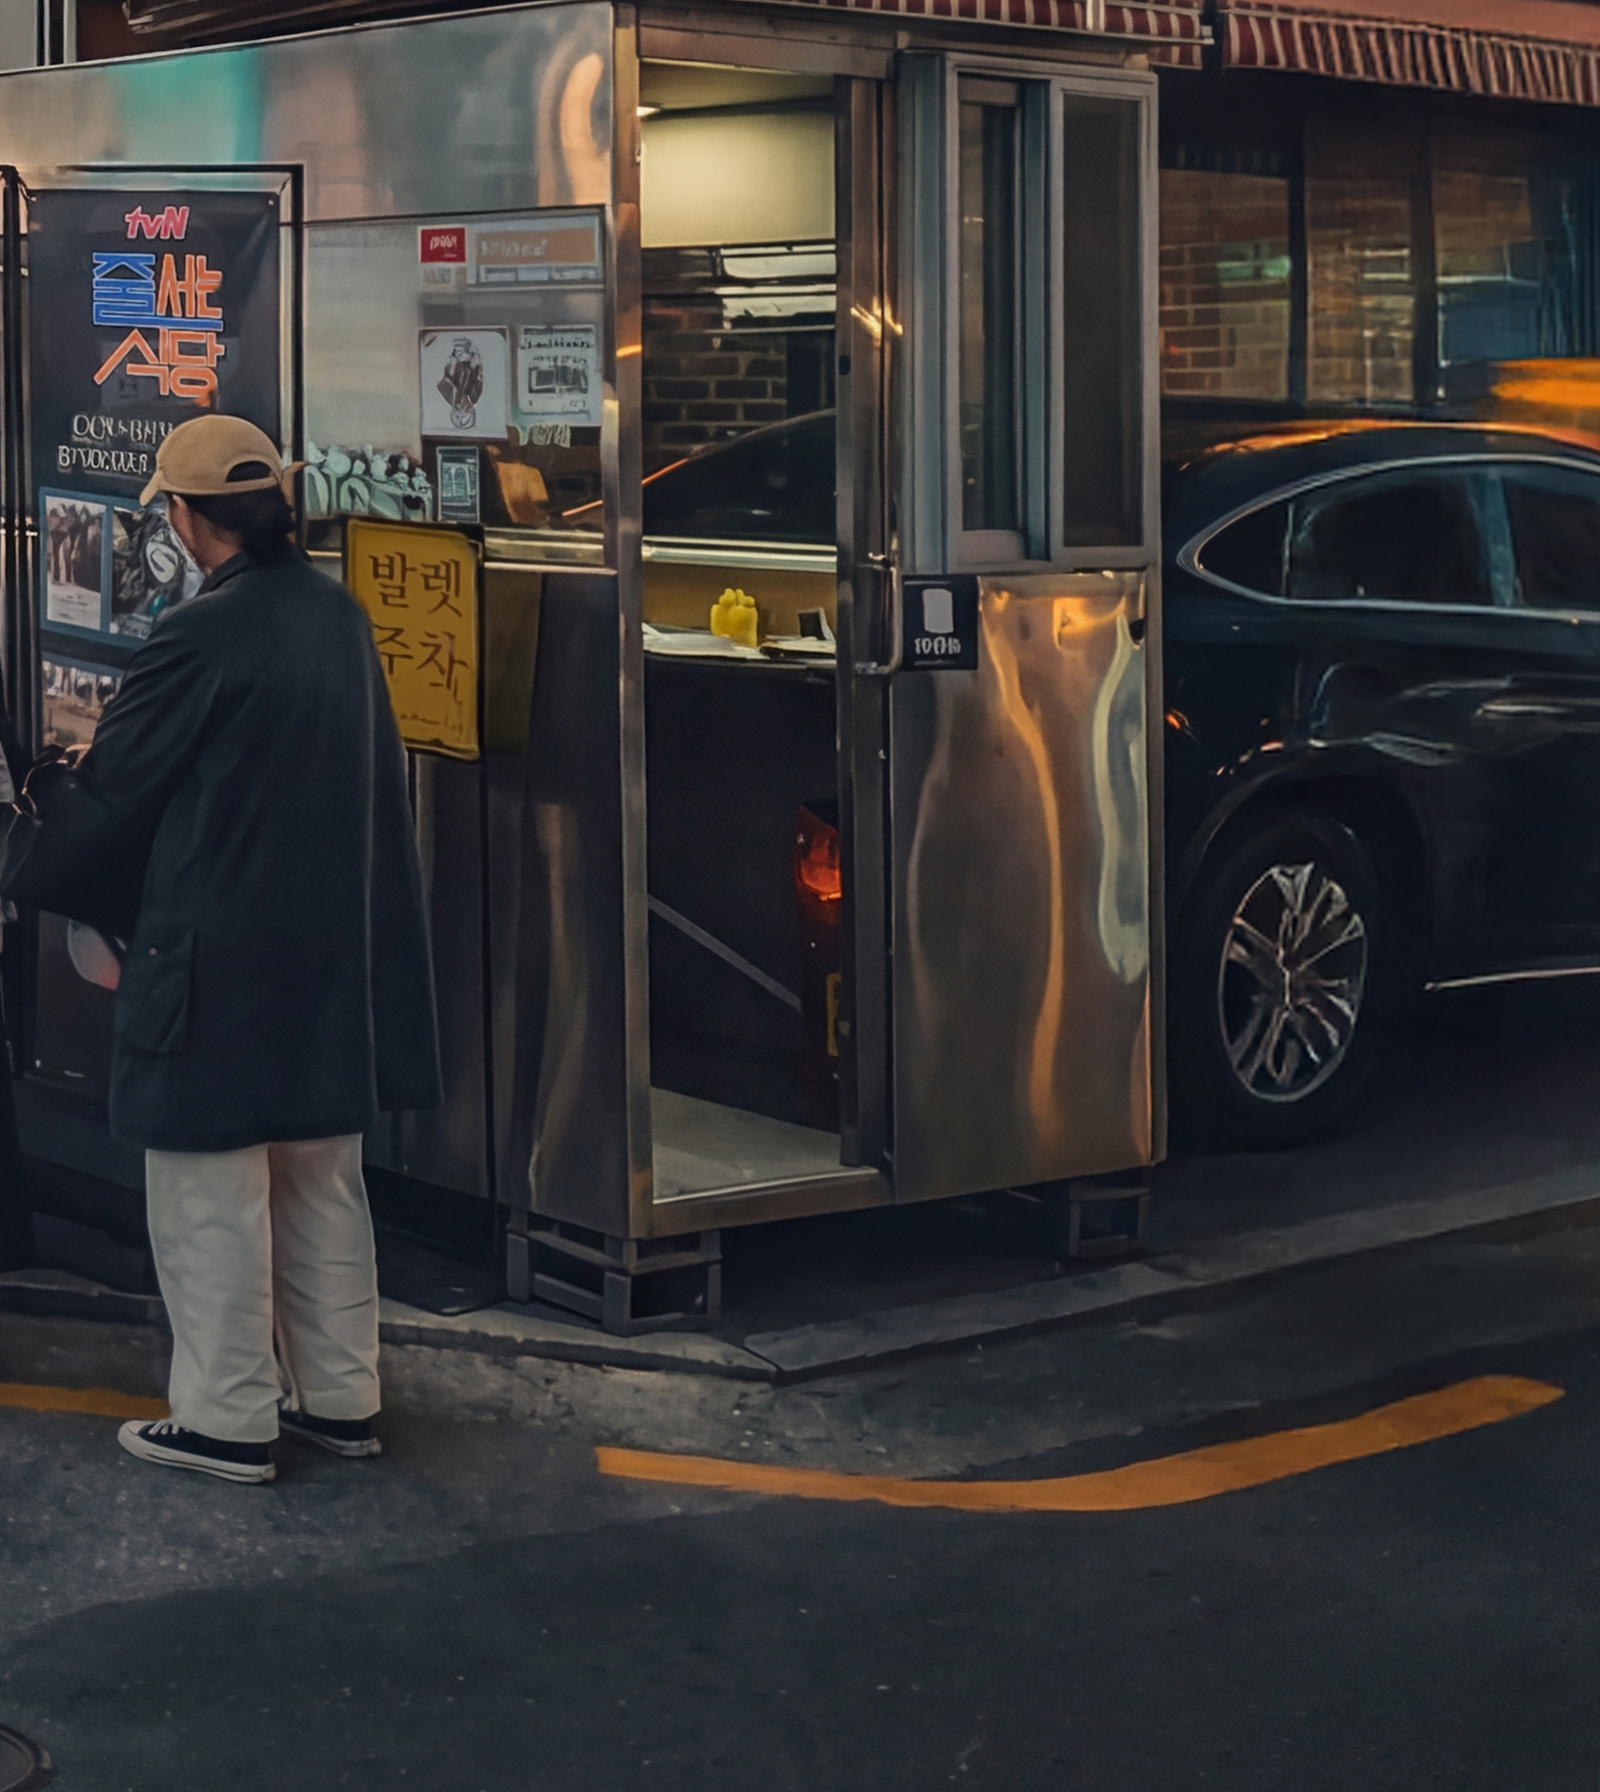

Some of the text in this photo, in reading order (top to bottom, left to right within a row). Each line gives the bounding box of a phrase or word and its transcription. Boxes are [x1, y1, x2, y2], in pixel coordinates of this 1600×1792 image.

[125, 205, 190, 240] tvN
[93, 326, 226, 398] 식당
[368, 551, 464, 619] 발렛
